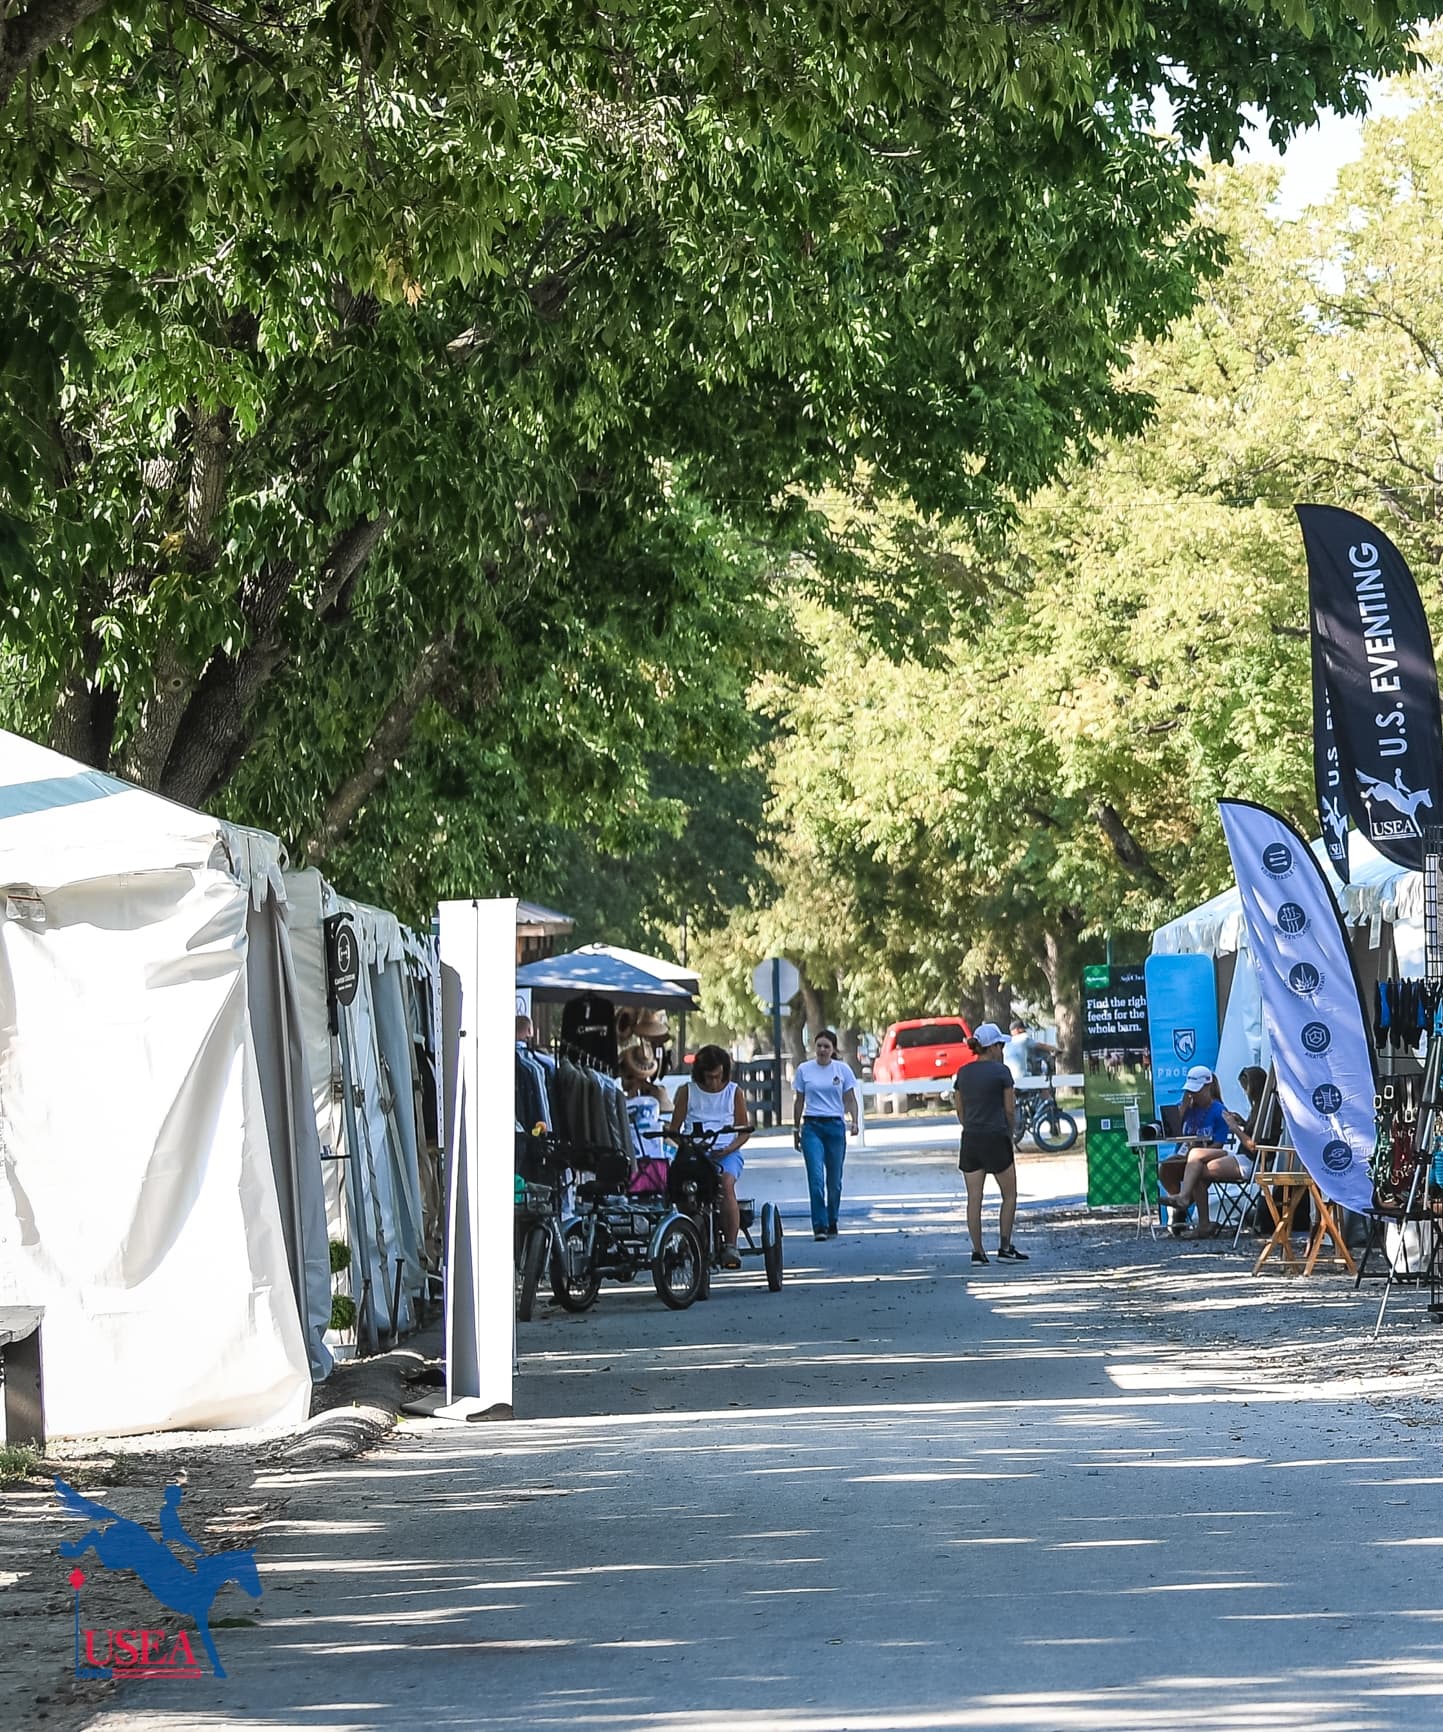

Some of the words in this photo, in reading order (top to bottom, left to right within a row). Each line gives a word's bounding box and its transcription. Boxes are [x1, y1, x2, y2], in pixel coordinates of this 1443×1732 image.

[1349, 542, 1403, 693] EVENTING
[1375, 702, 1408, 757] U.S.
[1372, 820, 1416, 837] USEA
[1087, 997, 1109, 1010] Find
[1110, 996, 1126, 1008] the
[1128, 995, 1146, 1009] righ
[1087, 1010, 1112, 1022] feeds
[1114, 1009, 1128, 1020] for
[1129, 1008, 1145, 1019] the
[1088, 1021, 1117, 1034] whole
